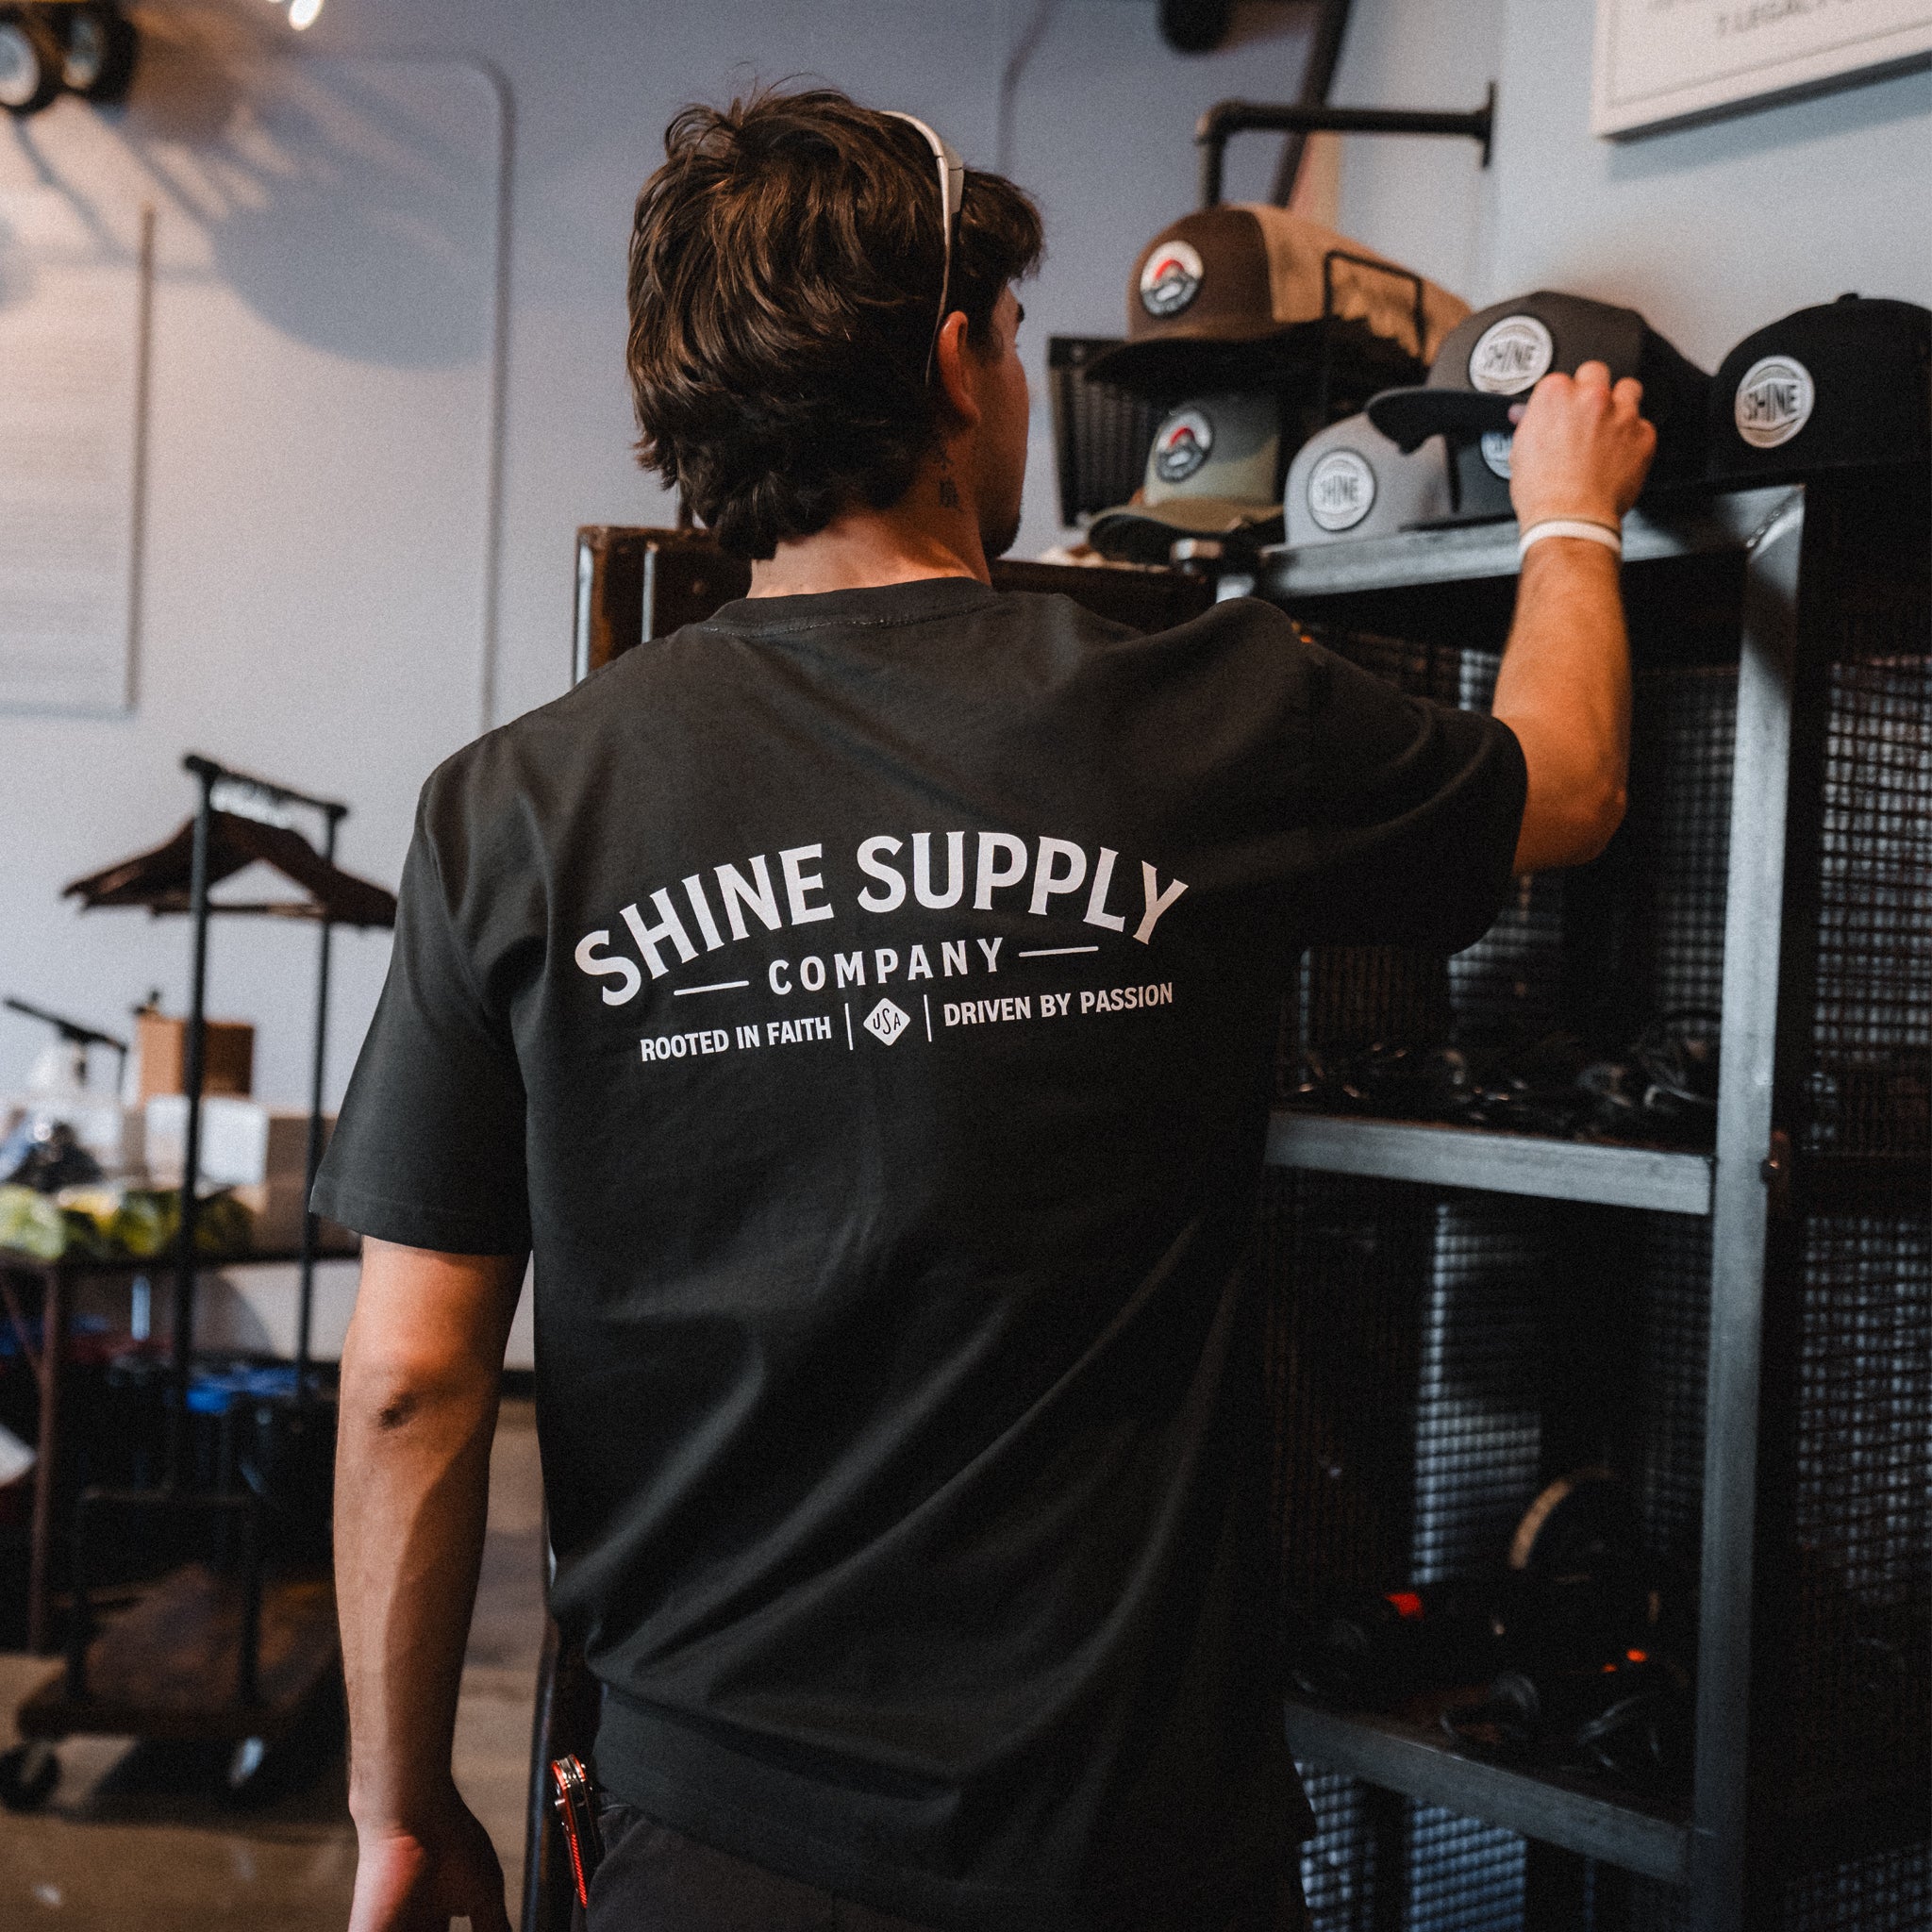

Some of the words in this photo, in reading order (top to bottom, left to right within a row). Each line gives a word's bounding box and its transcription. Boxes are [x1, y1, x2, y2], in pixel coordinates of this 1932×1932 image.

[1743, 383, 1798, 423] SHINE
[575, 842, 834, 1007] SHINE
[857, 830, 1190, 945] SUPPLY
[768, 938, 1004, 996] COMPANY
[641, 1029, 730, 1062] ROOTED
[735, 1024, 761, 1050] IN
[766, 1015, 832, 1046] FAITH
[873, 1008, 901, 1035] USA
[944, 996, 1032, 1027] DRIVEN
[1040, 993, 1072, 1018] BY
[1080, 983, 1173, 1014] PASSION
